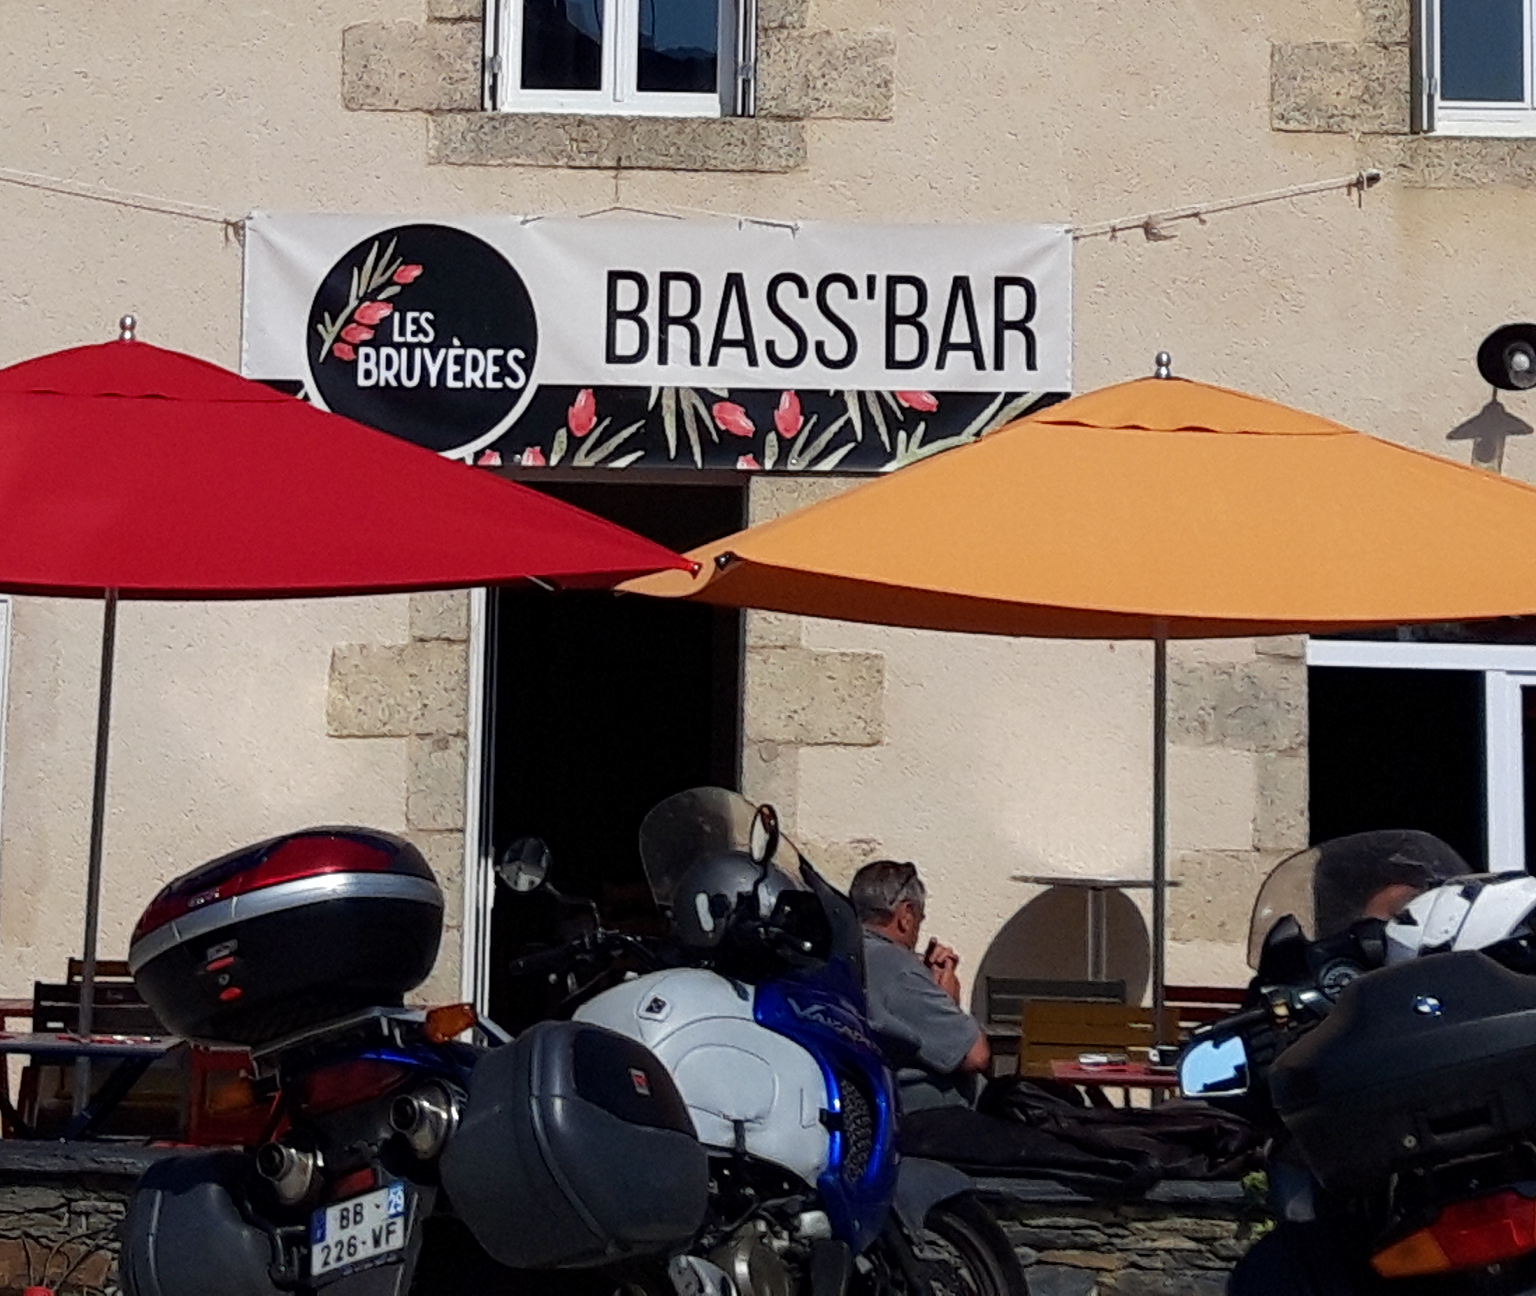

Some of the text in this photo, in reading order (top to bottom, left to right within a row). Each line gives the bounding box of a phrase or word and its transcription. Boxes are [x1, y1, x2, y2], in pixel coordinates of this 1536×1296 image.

[391, 310, 436, 344] LES
[603, 269, 1039, 372] BRASS'BAR
[356, 334, 527, 391] BRUYÈRES
